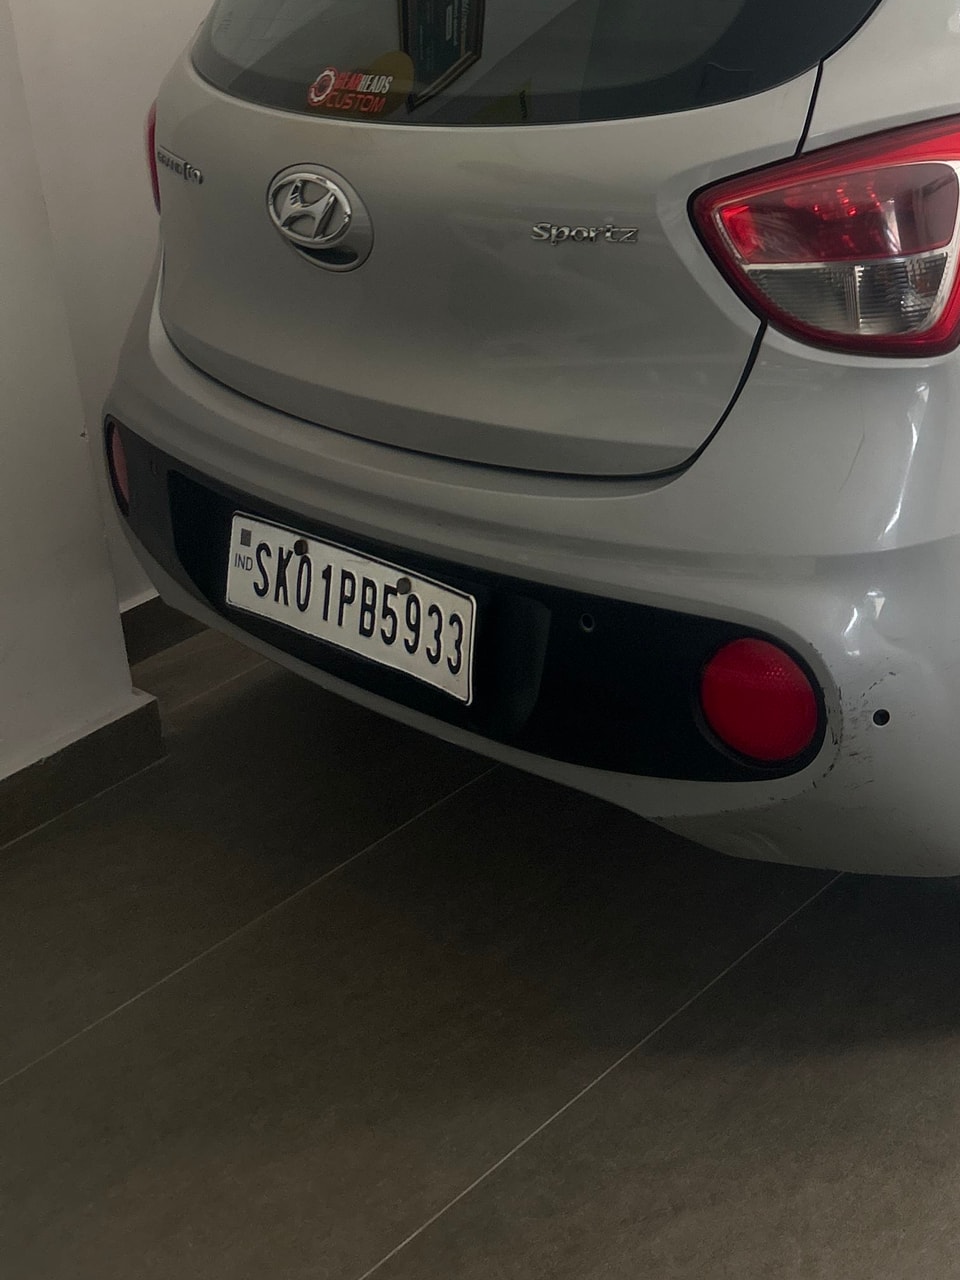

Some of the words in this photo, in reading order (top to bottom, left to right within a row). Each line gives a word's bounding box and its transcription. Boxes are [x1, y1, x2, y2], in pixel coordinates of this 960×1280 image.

[325, 91, 386, 113] CUSTOM
[530, 222, 639, 246] Sportz
[234, 552, 253, 572] IND
[253, 542, 464, 676] SK01PB5933
